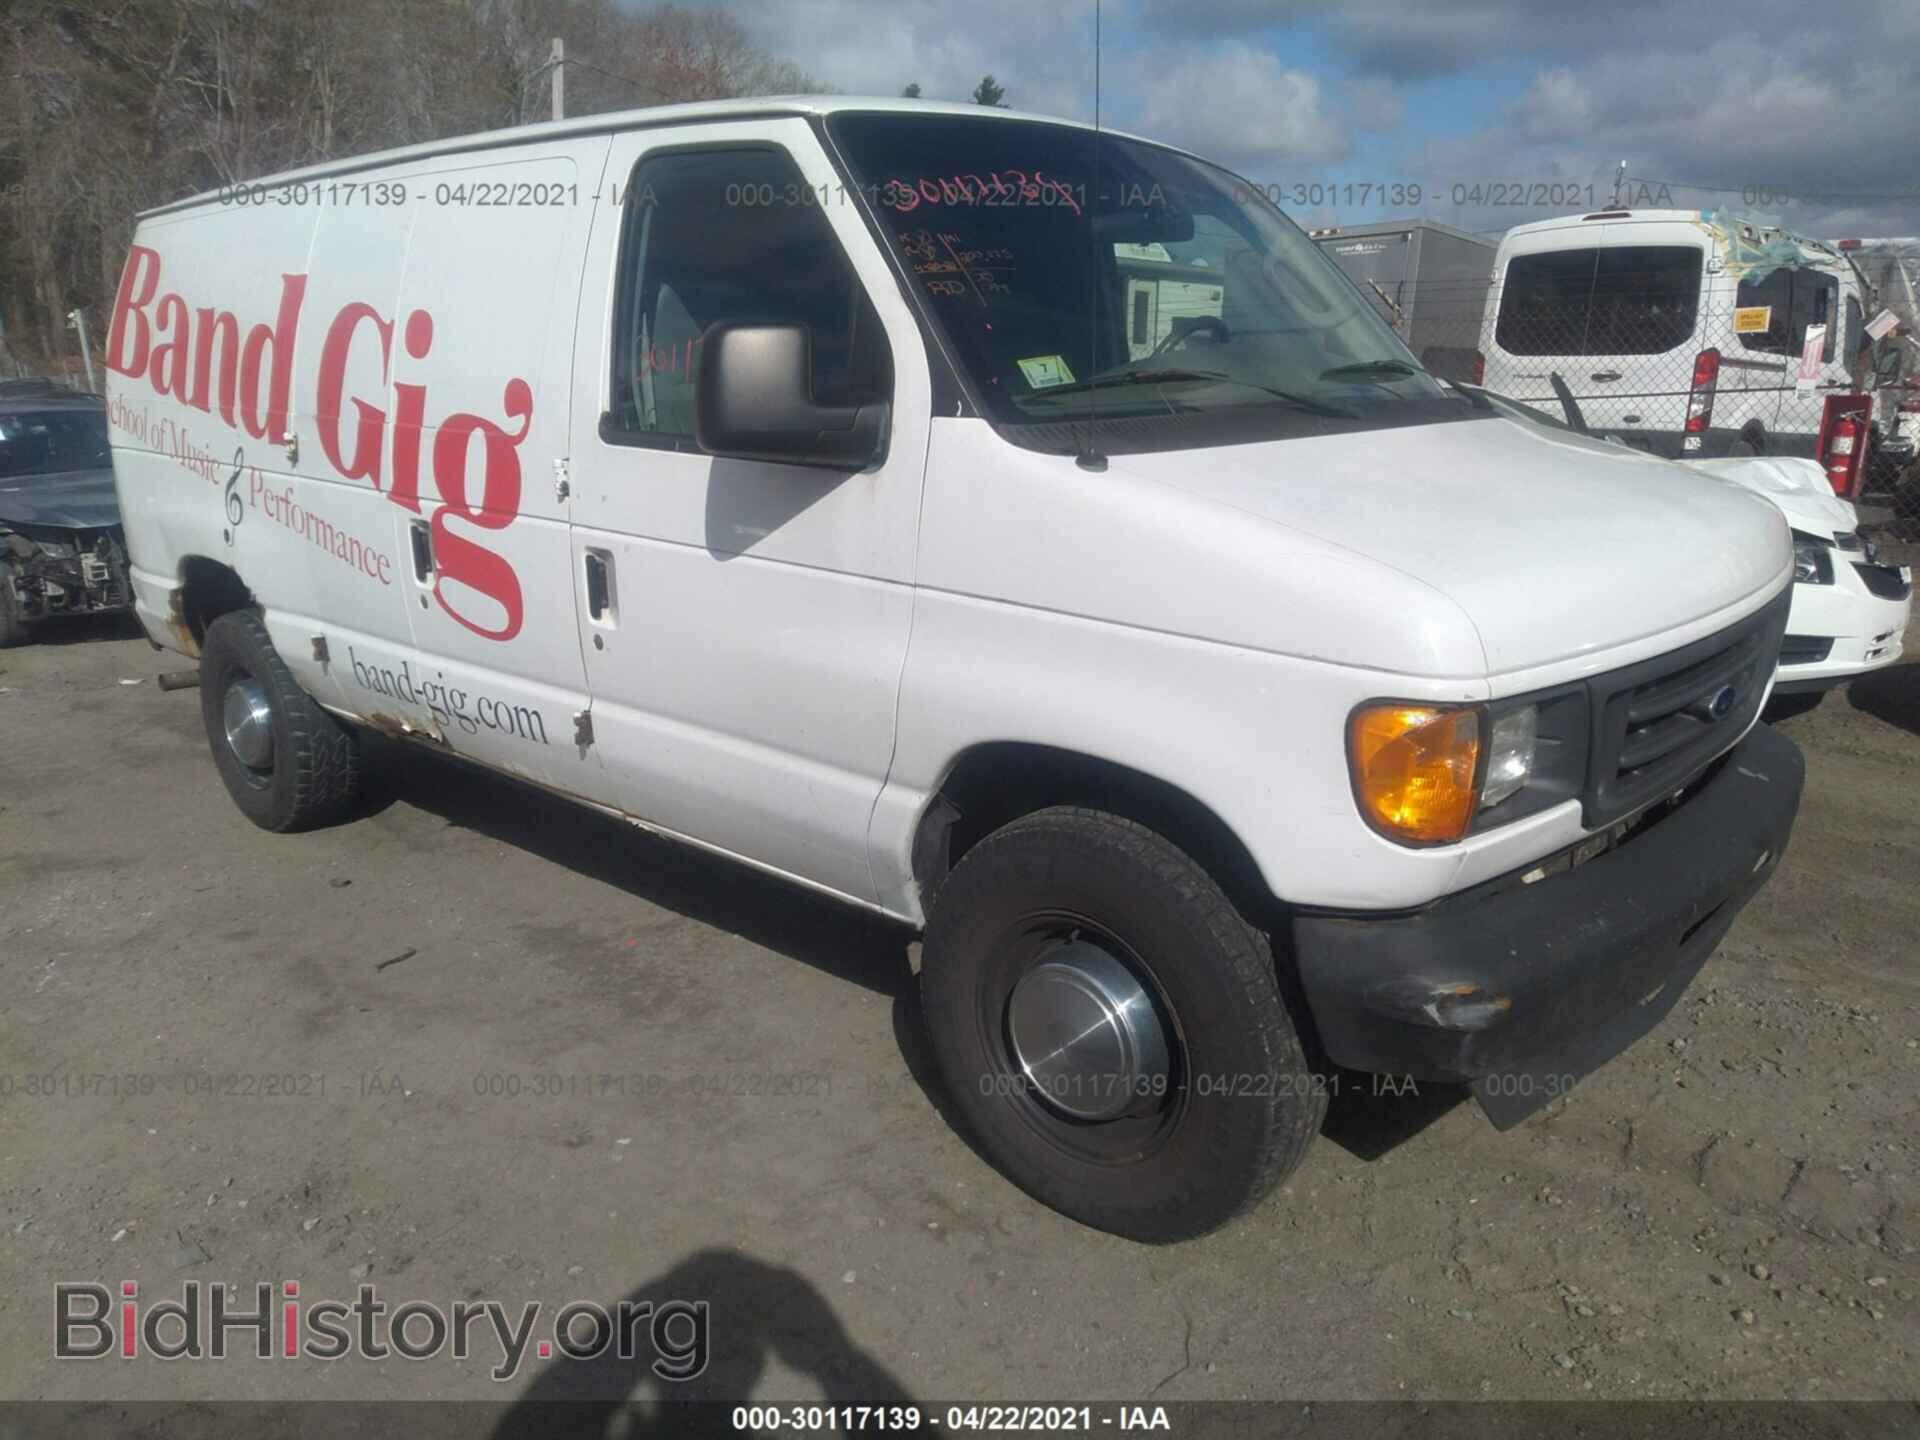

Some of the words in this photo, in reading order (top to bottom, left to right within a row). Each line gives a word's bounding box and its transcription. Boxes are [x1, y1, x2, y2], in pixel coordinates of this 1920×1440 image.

[105, 245, 308, 445] Band
[316, 302, 533, 641] Gig
[151, 417, 168, 452] of
[168, 420, 221, 485] Music
[247, 467, 392, 585] Performance
[348, 646, 550, 745] band-gig.com
